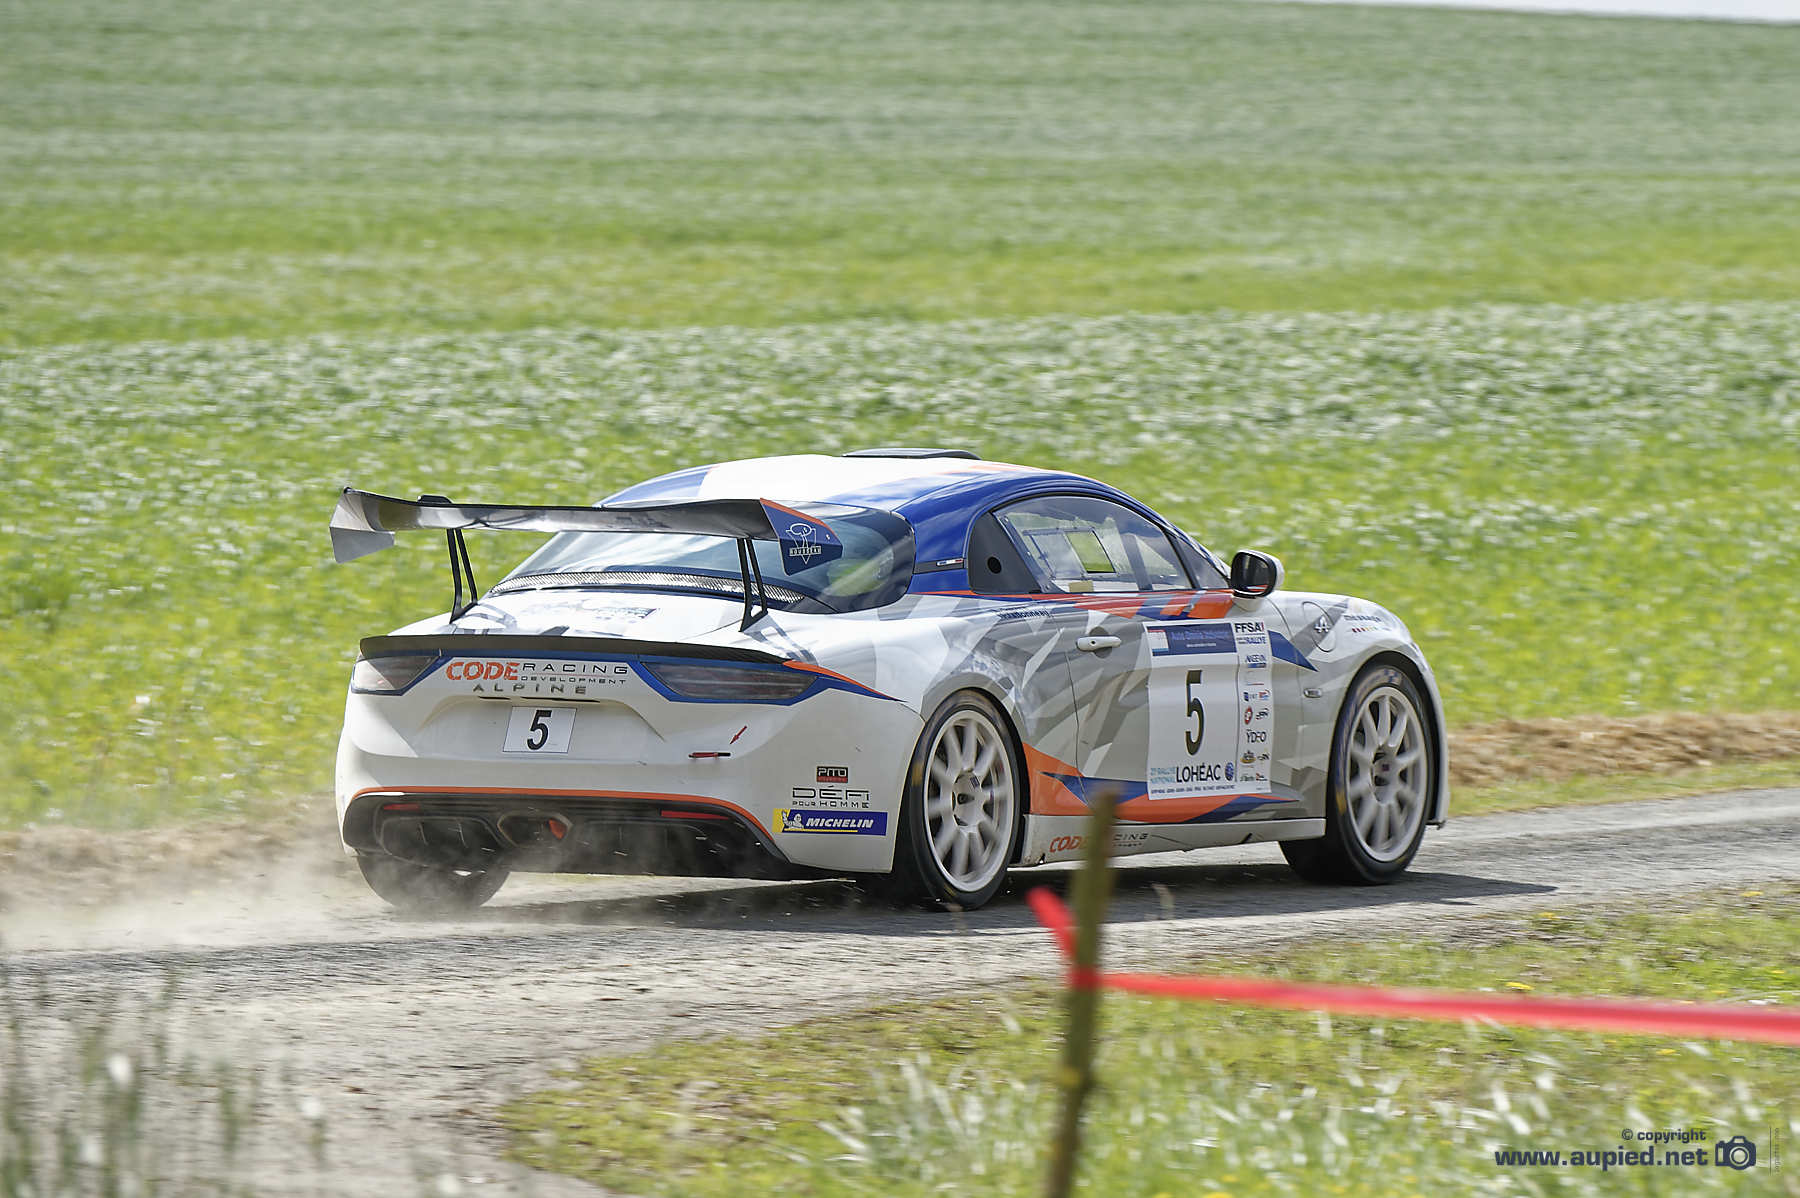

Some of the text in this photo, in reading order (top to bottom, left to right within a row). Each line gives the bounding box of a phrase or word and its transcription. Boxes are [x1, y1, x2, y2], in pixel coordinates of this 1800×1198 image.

[1234, 622, 1264, 633] FFSA
[446, 661, 628, 681] CODE RACING
[521, 675, 627, 685] DEVELOPMENT
[473, 683, 587, 695] ALPINE
[1185, 669, 1205, 756] 5
[526, 709, 552, 751] 5
[1176, 762, 1221, 783] LOHÉAC
[819, 800, 870, 809] HOMME
[805, 817, 874, 828] MICHELIN
